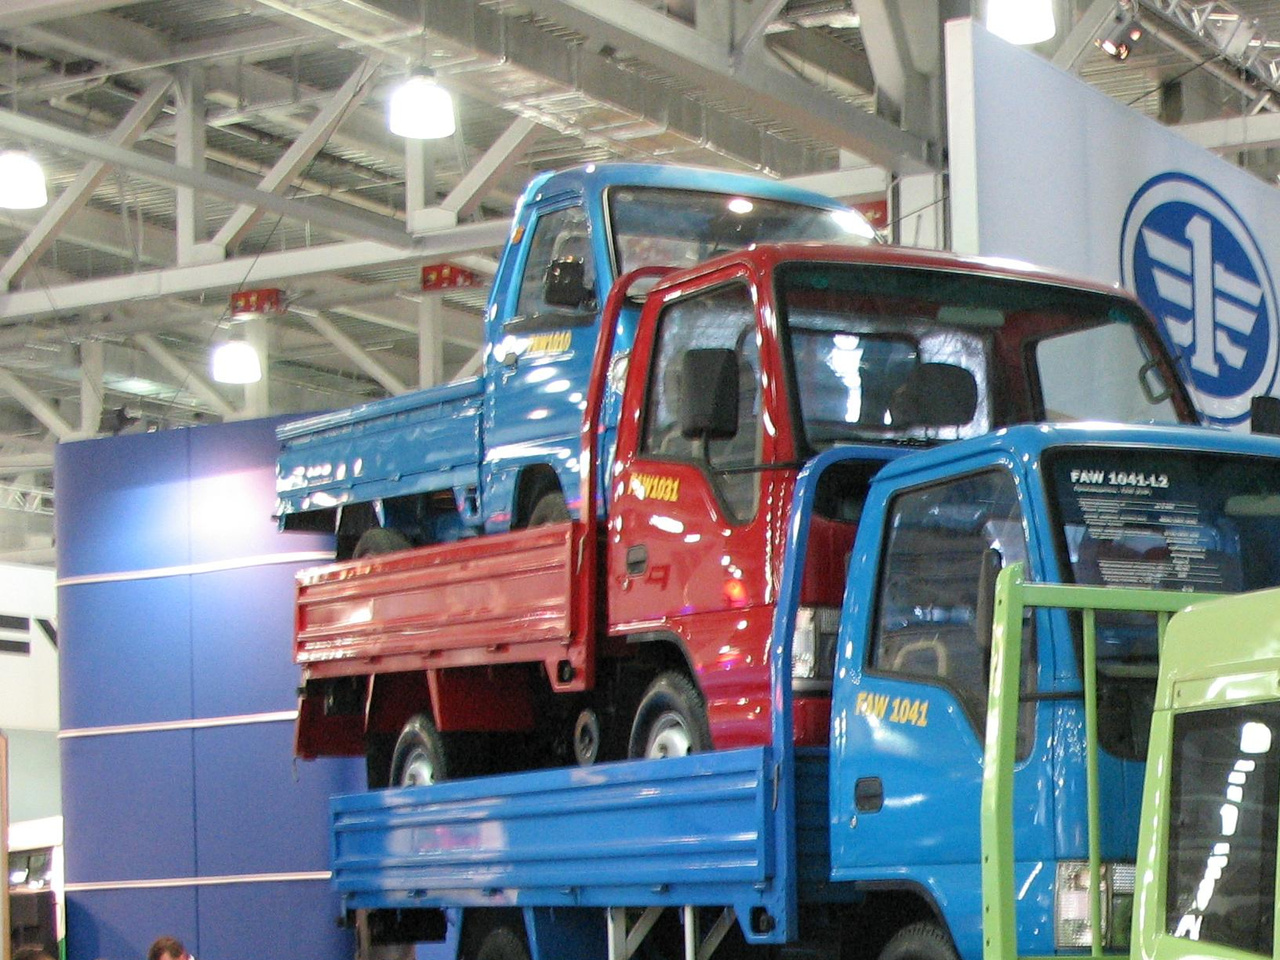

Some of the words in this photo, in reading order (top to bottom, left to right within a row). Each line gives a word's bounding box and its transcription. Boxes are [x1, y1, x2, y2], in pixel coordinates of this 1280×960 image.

[1070, 469, 1104, 484] FAW
[1108, 470, 1169, 488] 1041-L2
[855, 692, 889, 719] FAW
[889, 697, 929, 727] 1041
